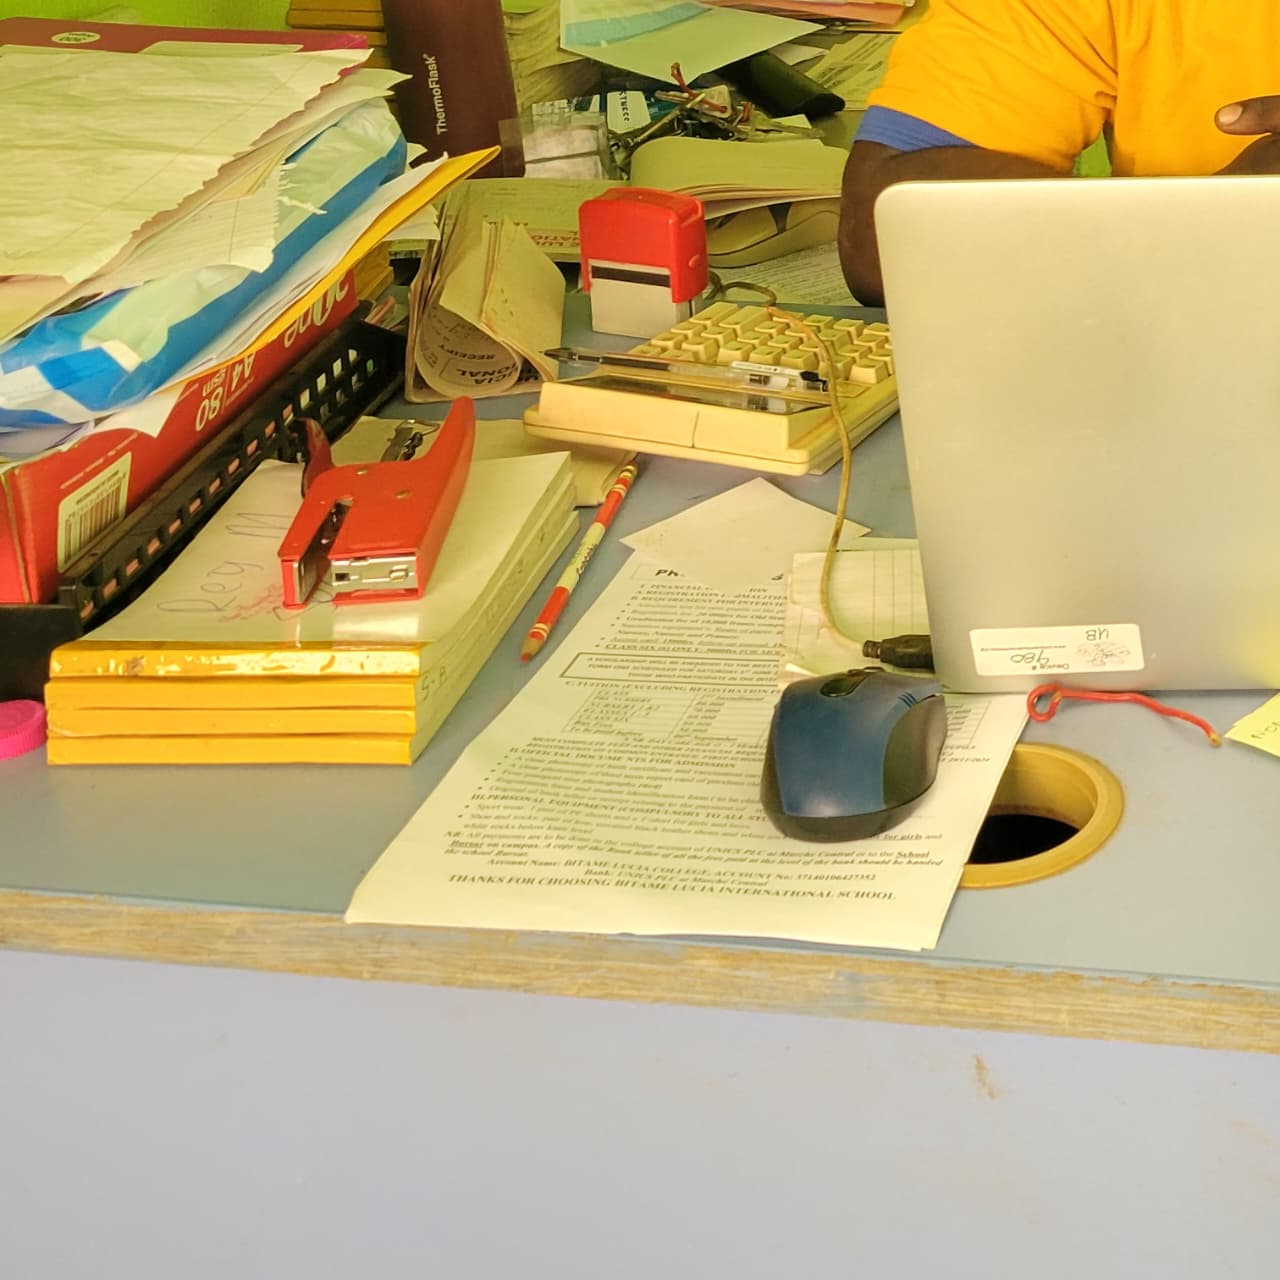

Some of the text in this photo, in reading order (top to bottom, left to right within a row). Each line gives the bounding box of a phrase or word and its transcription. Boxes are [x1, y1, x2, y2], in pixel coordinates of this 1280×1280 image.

[423, 55, 448, 135] ThermoFlask
[231, 353, 256, 393] A4
[195, 387, 223, 432] 80
[449, 874, 504, 884] THANKS
[507, 876, 536, 885] FOR
[538, 877, 611, 887] CHOOSING
[719, 886, 835, 899] INTERNATIONAL
[837, 890, 897, 901] SCHOOL
